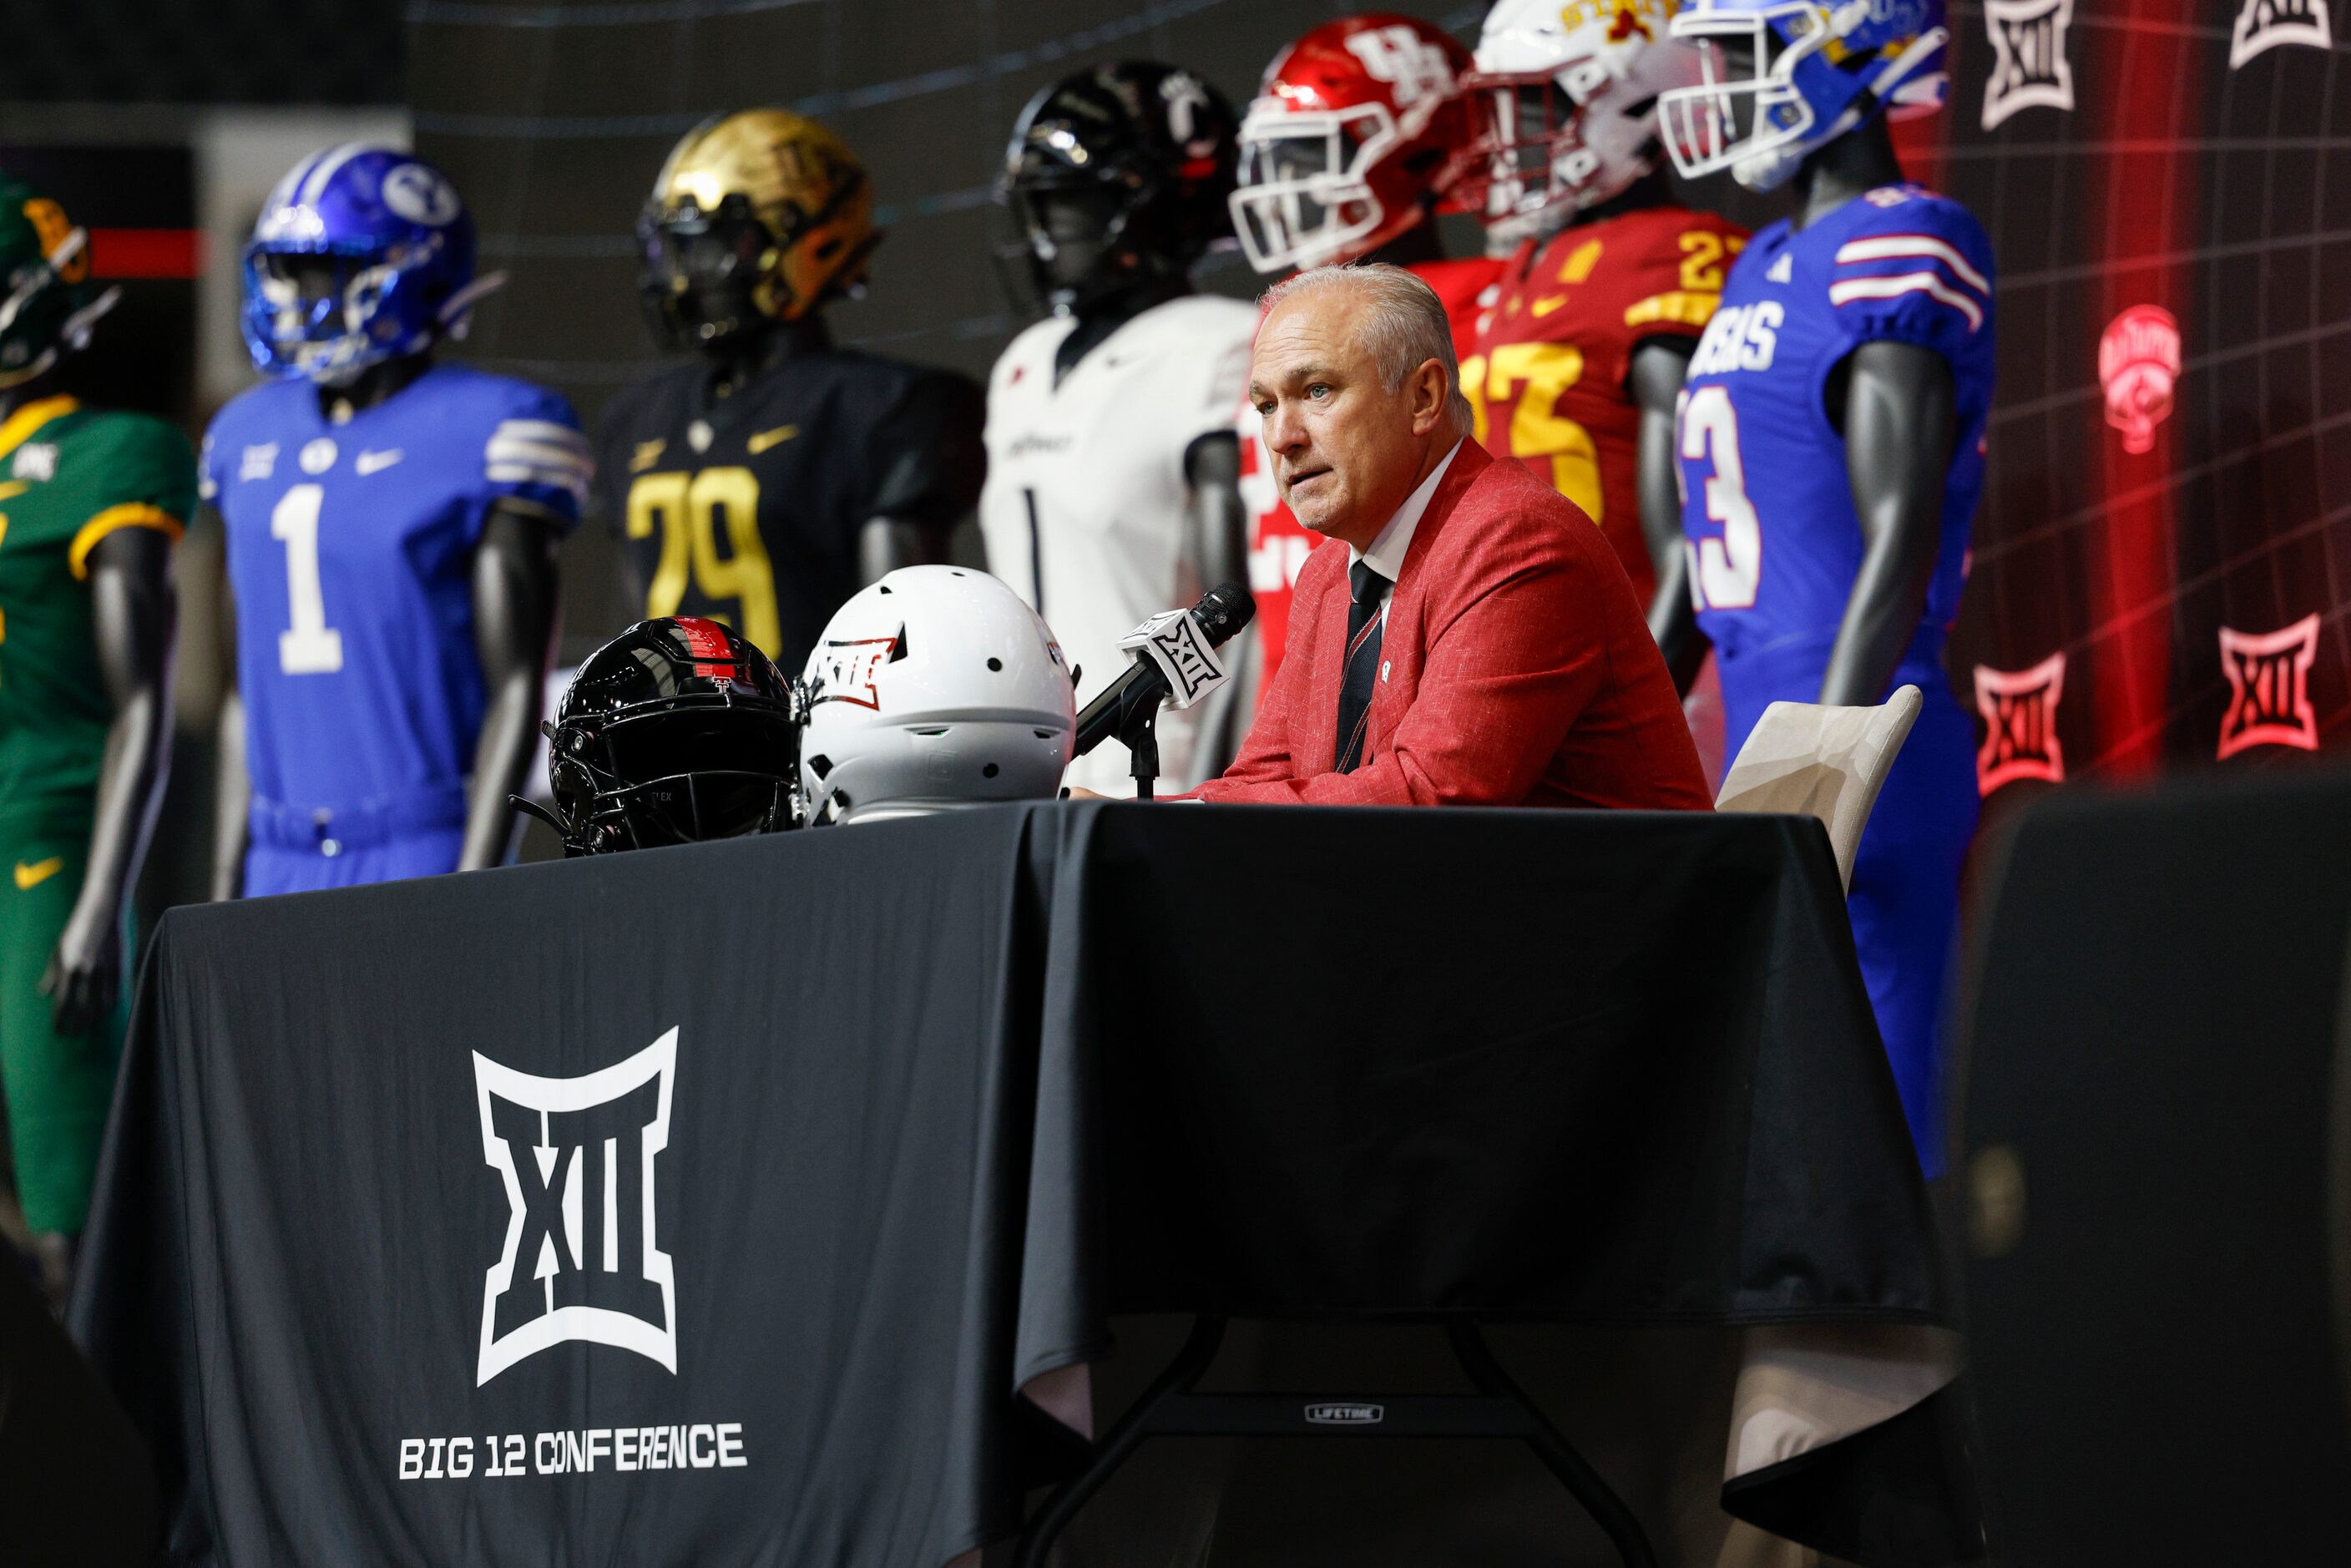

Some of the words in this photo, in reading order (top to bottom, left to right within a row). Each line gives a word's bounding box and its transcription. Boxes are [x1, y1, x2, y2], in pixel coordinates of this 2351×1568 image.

[270, 483, 344, 675] 1
[626, 466, 782, 661] 79
[399, 1438, 473, 1479] BIG
[484, 1434, 526, 1476] 12
[534, 1423, 748, 1475] CONFERENCE
[1313, 1406, 1374, 1419] LIFETIME
